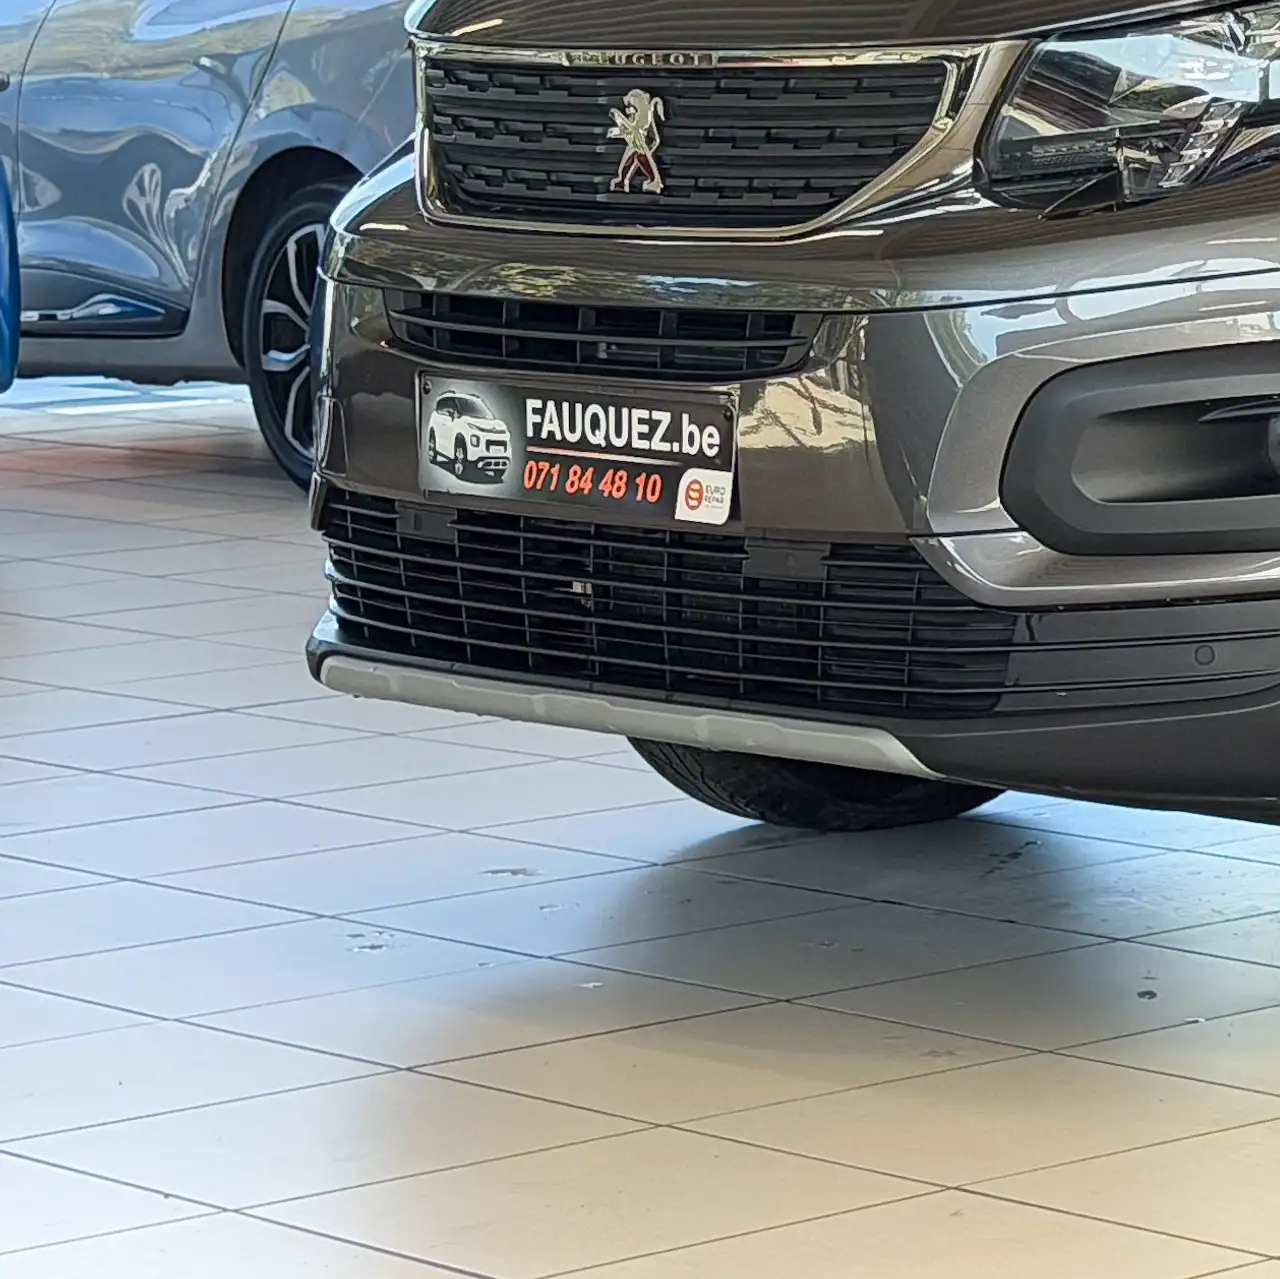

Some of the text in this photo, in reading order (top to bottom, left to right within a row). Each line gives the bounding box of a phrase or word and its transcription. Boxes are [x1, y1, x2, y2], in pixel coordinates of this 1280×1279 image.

[525, 398, 721, 457] FAUQUEZ.be
[523, 460, 662, 503] 071 84 48 10
